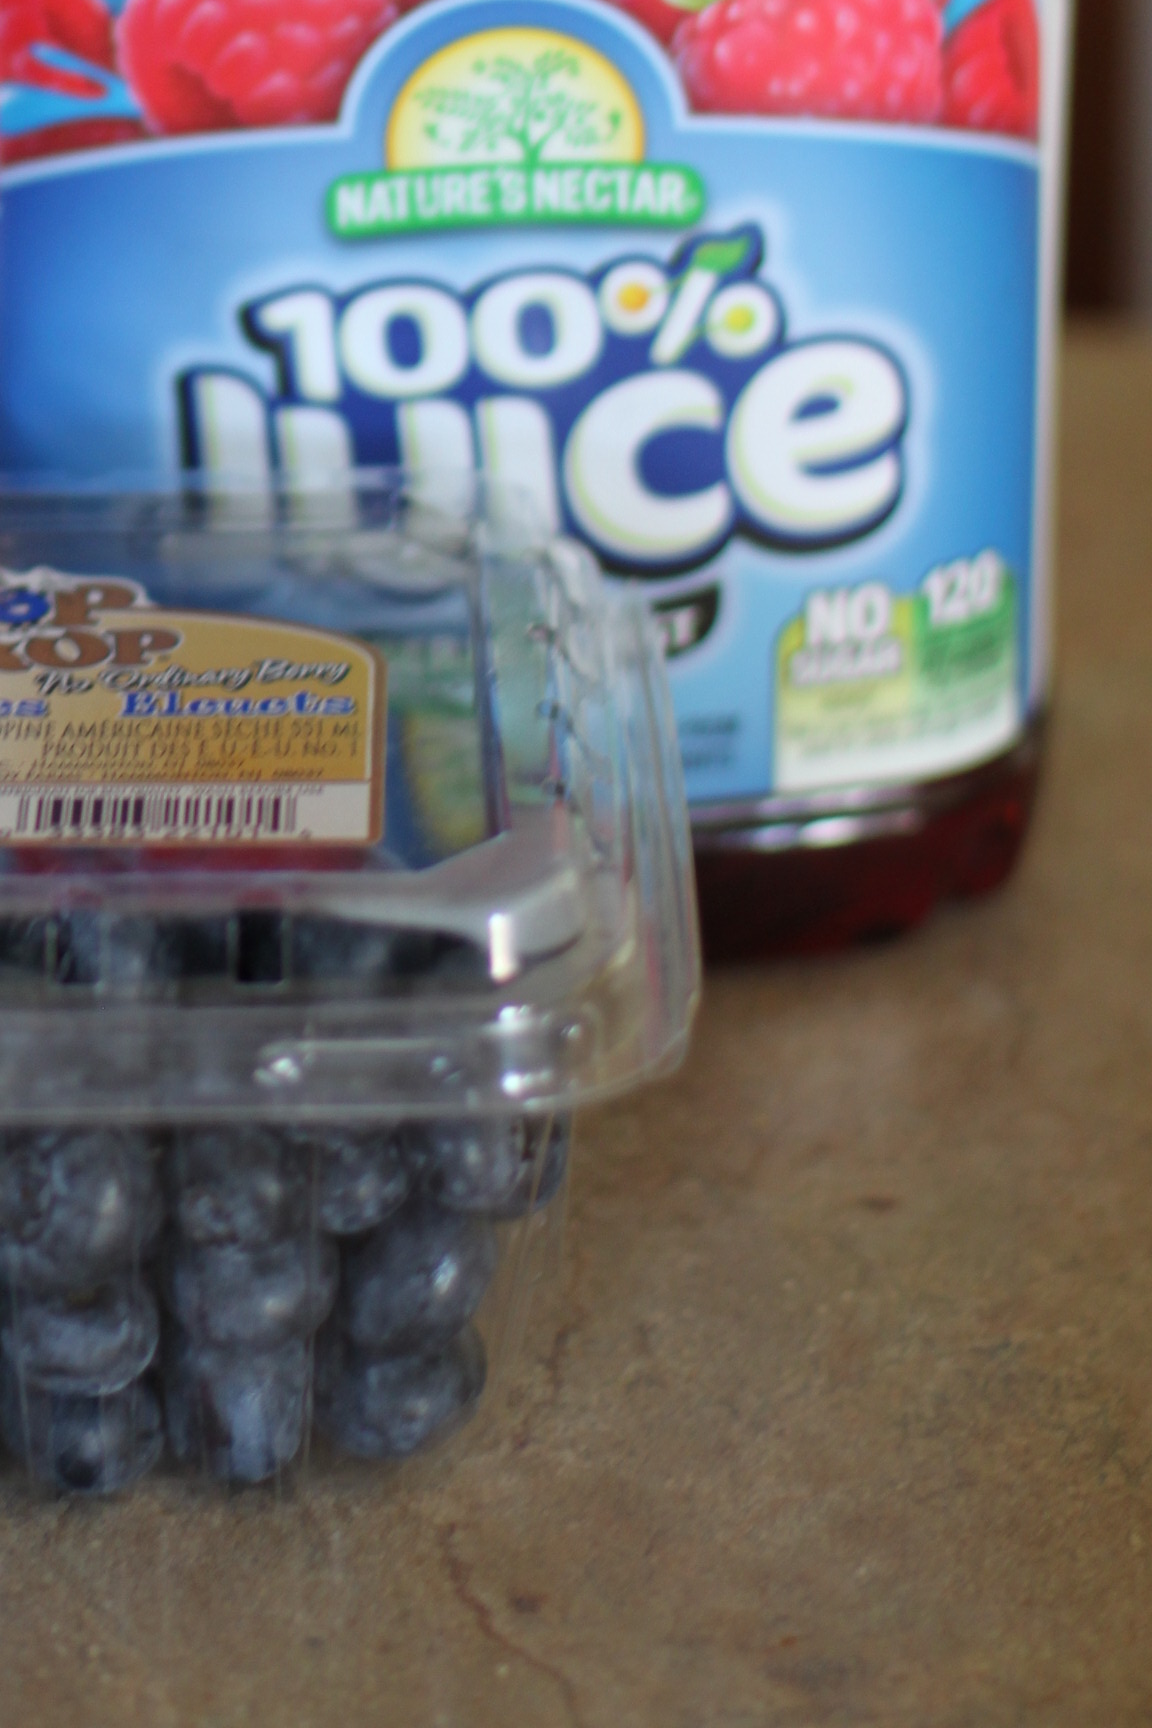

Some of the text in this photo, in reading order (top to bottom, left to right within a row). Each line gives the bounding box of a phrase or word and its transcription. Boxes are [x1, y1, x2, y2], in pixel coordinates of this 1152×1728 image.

[334, 164, 686, 230] NATURE'S NECTAR
[244, 224, 783, 405] 100%
[807, 582, 891, 646] NO
[922, 547, 1004, 626] 120
[120, 690, 356, 718] Bleuets
